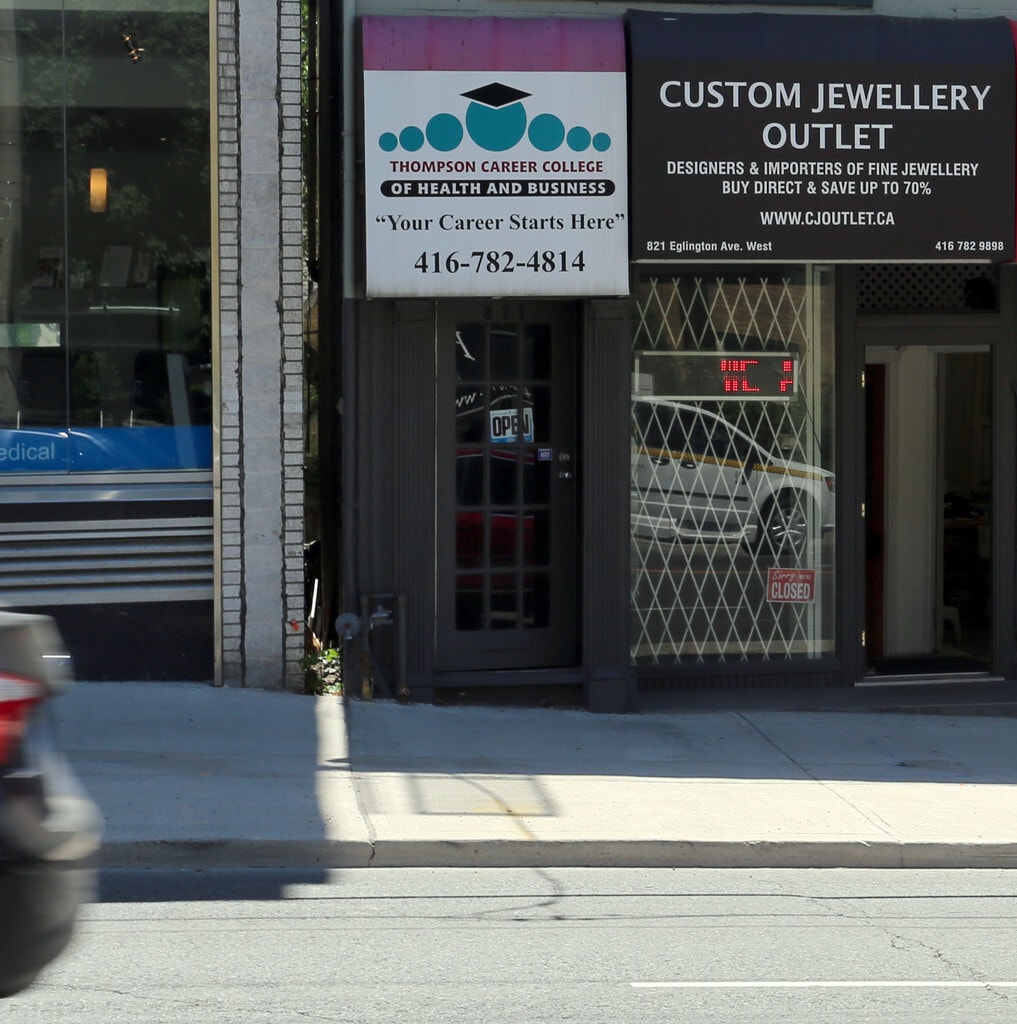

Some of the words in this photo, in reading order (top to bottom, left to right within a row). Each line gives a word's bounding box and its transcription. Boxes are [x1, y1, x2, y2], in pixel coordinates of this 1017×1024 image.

[659, 80, 801, 108] CUSTOM
[811, 83, 991, 113] JEWELLERY
[762, 122, 893, 150] OUTLET
[390, 160, 476, 173] THOMPSON
[481, 160, 537, 173] CAREER
[542, 160, 603, 173] COLLEGE
[667, 161, 744, 176] DESIGNERS
[750, 162, 759, 176] &
[764, 161, 842, 176] IMPORTERS
[847, 162, 864, 176] OF
[868, 162, 898, 176] FINE
[902, 163, 979, 177] JEWELLERY
[391, 182, 412, 195] OF
[418, 182, 481, 195] HEALTH
[486, 182, 522, 194] AND
[528, 182, 606, 194] BUSINESS
[722, 181, 749, 195] BUY
[754, 181, 802, 195] DIRECT
[807, 181, 817, 195] &
[821, 181, 856, 195] SAVE
[860, 181, 878, 195] UP
[882, 181, 899, 195] TO
[903, 181, 932, 195] 70%
[439, 214, 503, 231] Career
[509, 213, 564, 230] Starts
[760, 211, 895, 226] WWW.CJOUTLET.CA
[646, 241, 666, 252] 821
[669, 241, 718, 254] Eglington
[721, 241, 743, 251] Ave.
[746, 241, 772, 251] West
[935, 241, 954, 251] 416
[957, 241, 976, 251] 782
[979, 241, 1004, 251] 9898
[414, 250, 586, 274] 416-782-4814
[771, 582, 811, 599] CLOSED
